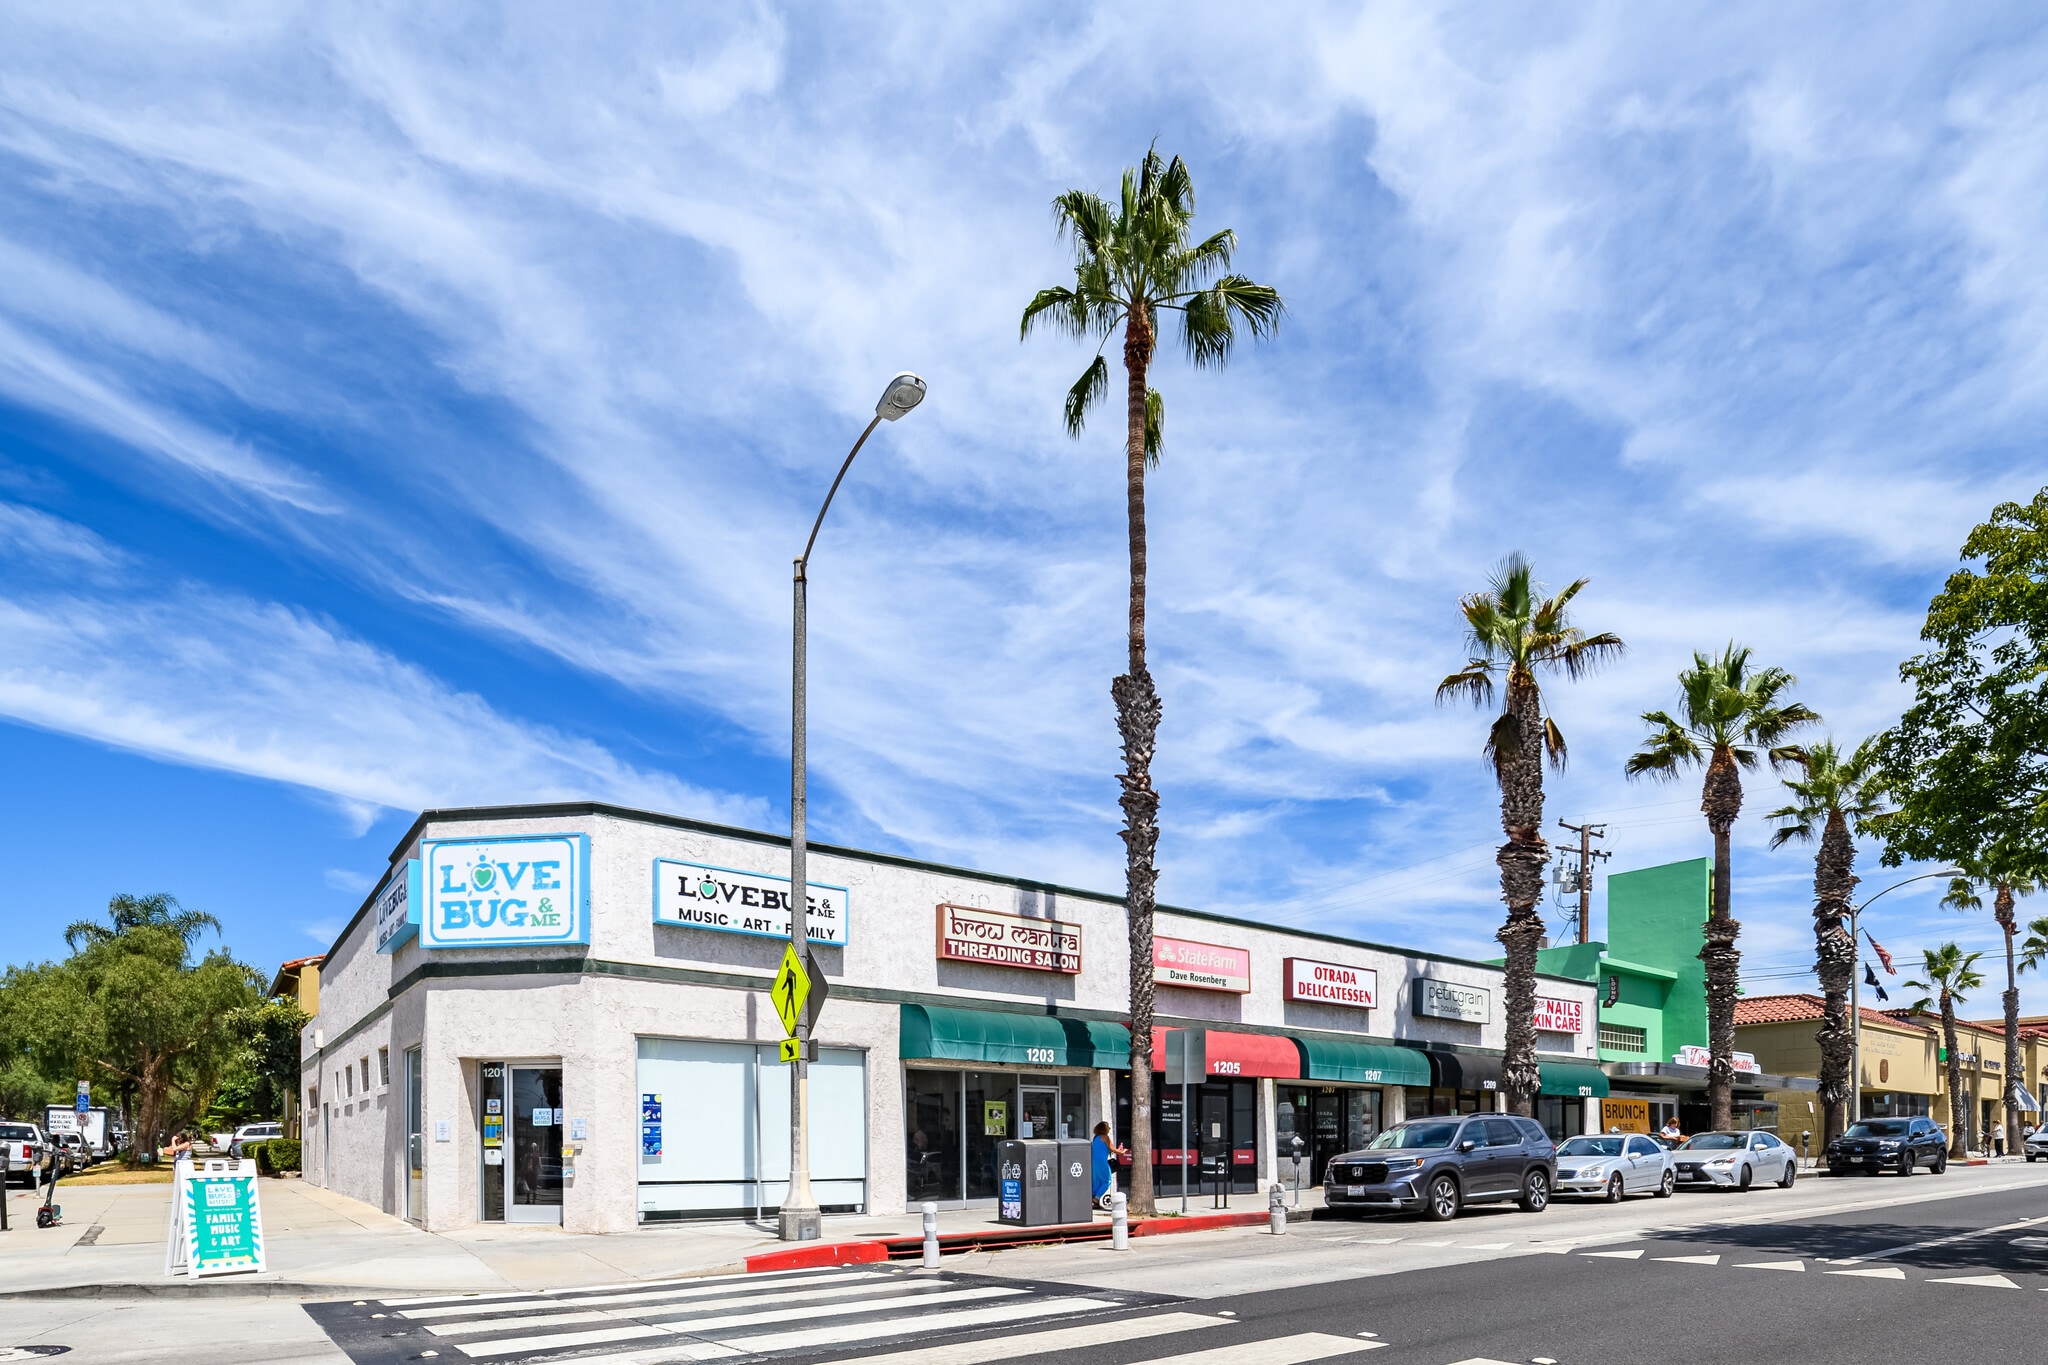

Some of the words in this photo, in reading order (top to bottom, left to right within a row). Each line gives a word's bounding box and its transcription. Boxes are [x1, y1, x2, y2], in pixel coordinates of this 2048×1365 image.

[440, 860, 561, 893] LOVE
[821, 898, 831, 909] &
[440, 898, 530, 930] BUG
[538, 897, 553, 913] &
[530, 913, 561, 927] ME
[817, 908, 836, 919] ME
[678, 907, 728, 926] MUSIC
[743, 917, 772, 932] ART
[785, 923, 836, 940] FMILY
[1010, 925, 1078, 951] mantra
[948, 940, 1032, 964] THREADING
[1035, 953, 1078, 970] SALON
[1170, 970, 1188, 980] Dave
[1189, 972, 1227, 988] Rosenberg
[1314, 966, 1357, 985] OTRADA
[1298, 981, 1372, 1004] DELICATESSEN
[1428, 986, 1484, 1007] petitgrain
[1441, 1003, 1472, 1017] boulangerie
[1546, 1000, 1581, 1017] NAILS
[1533, 1013, 1551, 1028] KIN
[1555, 1015, 1581, 1032] CARE
[1026, 1048, 1055, 1063] 1203
[1213, 1061, 1241, 1074] 1205
[1364, 1070, 1382, 1082] 1207
[1482, 1080, 1497, 1090] 1209
[1578, 1085, 1592, 1096] 1211
[1605, 1104, 1645, 1119] BRUNCH
[206, 1212, 243, 1225] FAMILY
[210, 1224, 240, 1235] MUSIC
[211, 1237, 218, 1247] &
[220, 1235, 241, 1247] ART
